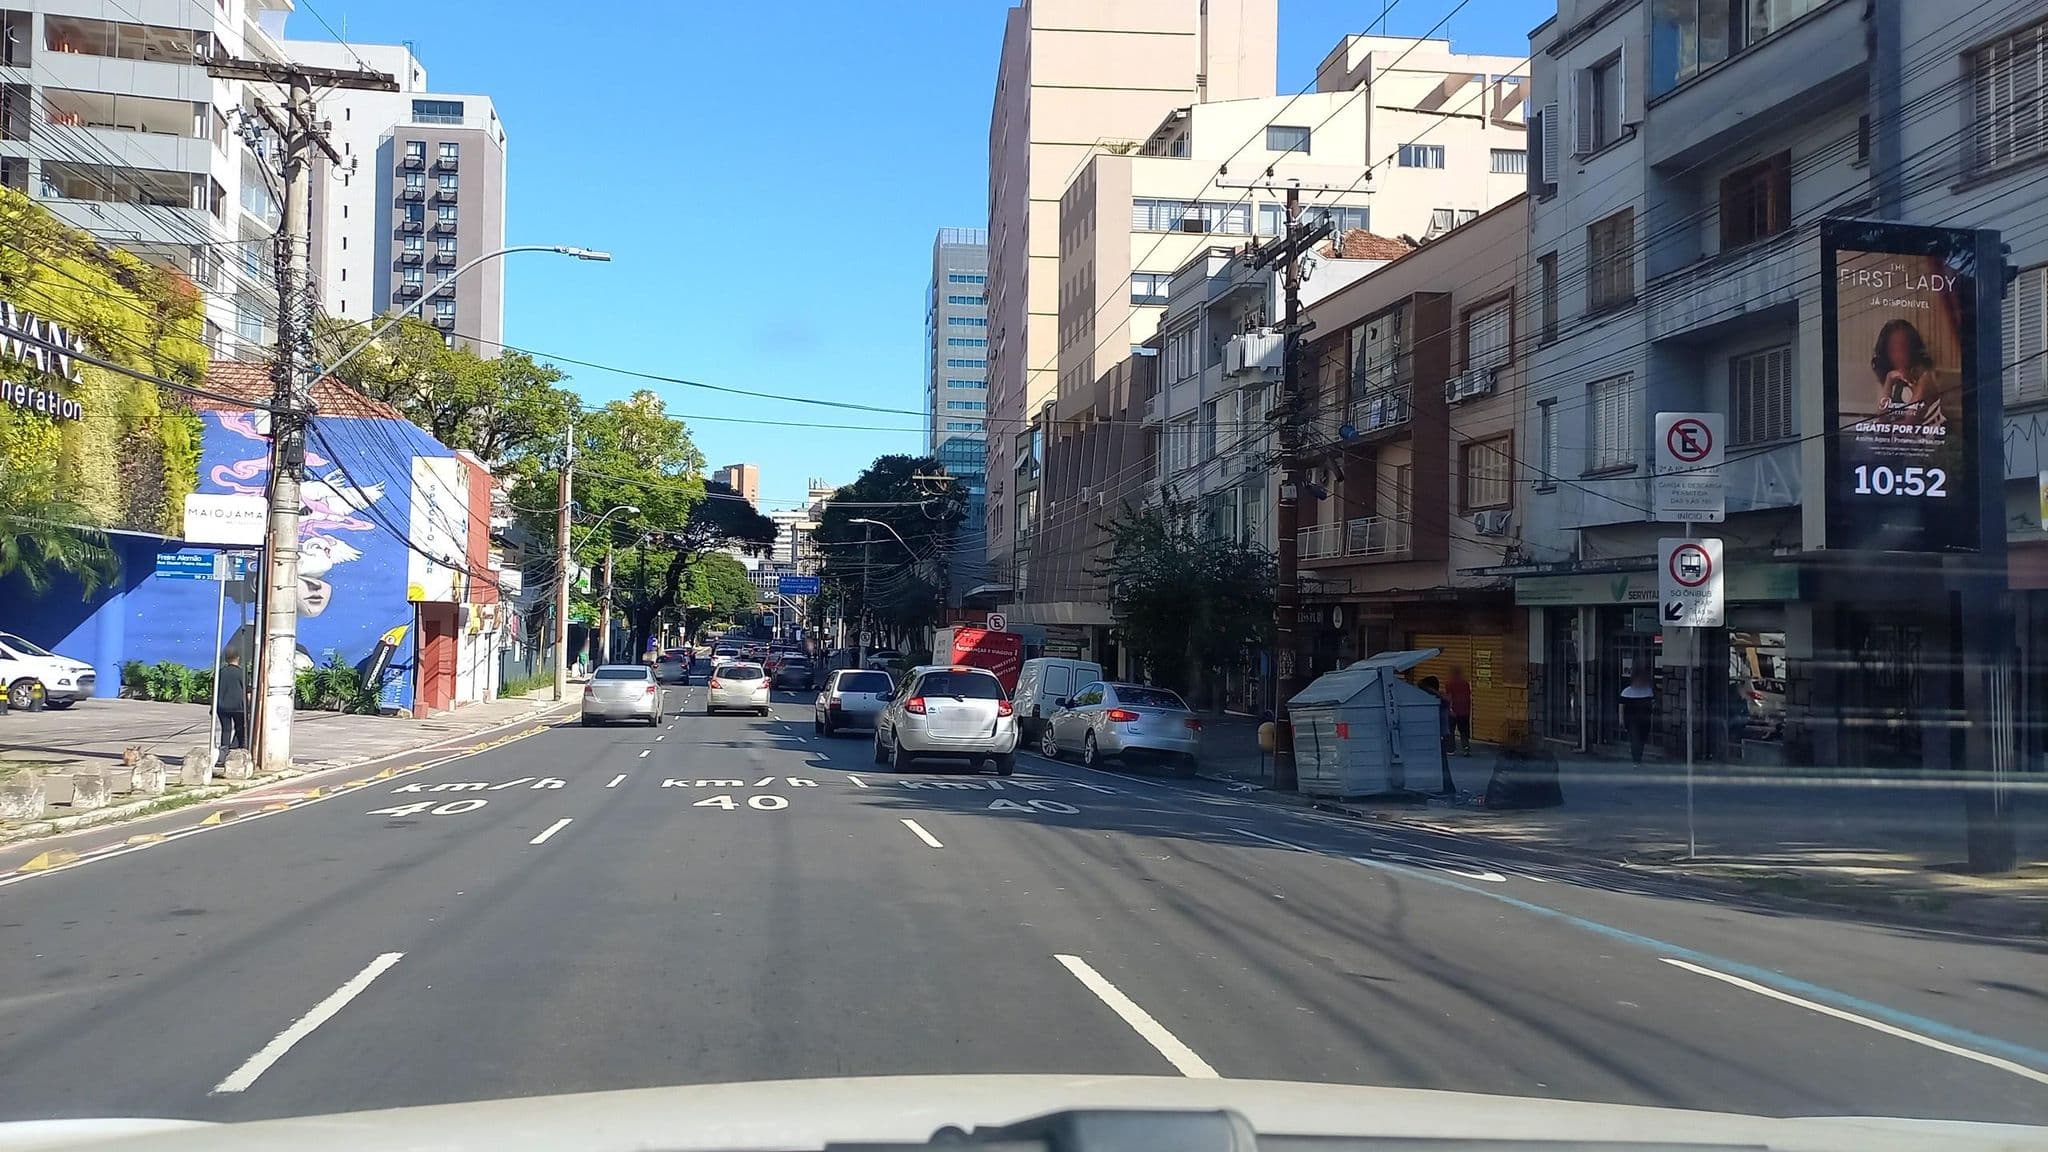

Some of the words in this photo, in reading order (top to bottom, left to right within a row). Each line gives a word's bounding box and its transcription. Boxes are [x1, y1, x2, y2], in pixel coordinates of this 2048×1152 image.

[1890, 263, 1906, 272] THE
[1840, 268, 1894, 289] FIRST
[1905, 273, 1957, 292] LADY
[1870, 297, 1881, 306] JÁ
[1882, 298, 1930, 309] DISPONÍVEL
[1855, 421, 1891, 433] GRÁTIS
[1892, 424, 1913, 434] POR
[1914, 425, 1922, 434] 7
[1922, 425, 1947, 436] DIAS
[1854, 465, 1947, 497] 10:52
[188, 508, 263, 519] MAIOJAMA
[392, 776, 567, 793] km/h
[661, 776, 819, 788] km/h
[366, 799, 489, 817] 40
[693, 794, 789, 810] 40
[988, 798, 1080, 814] 40
